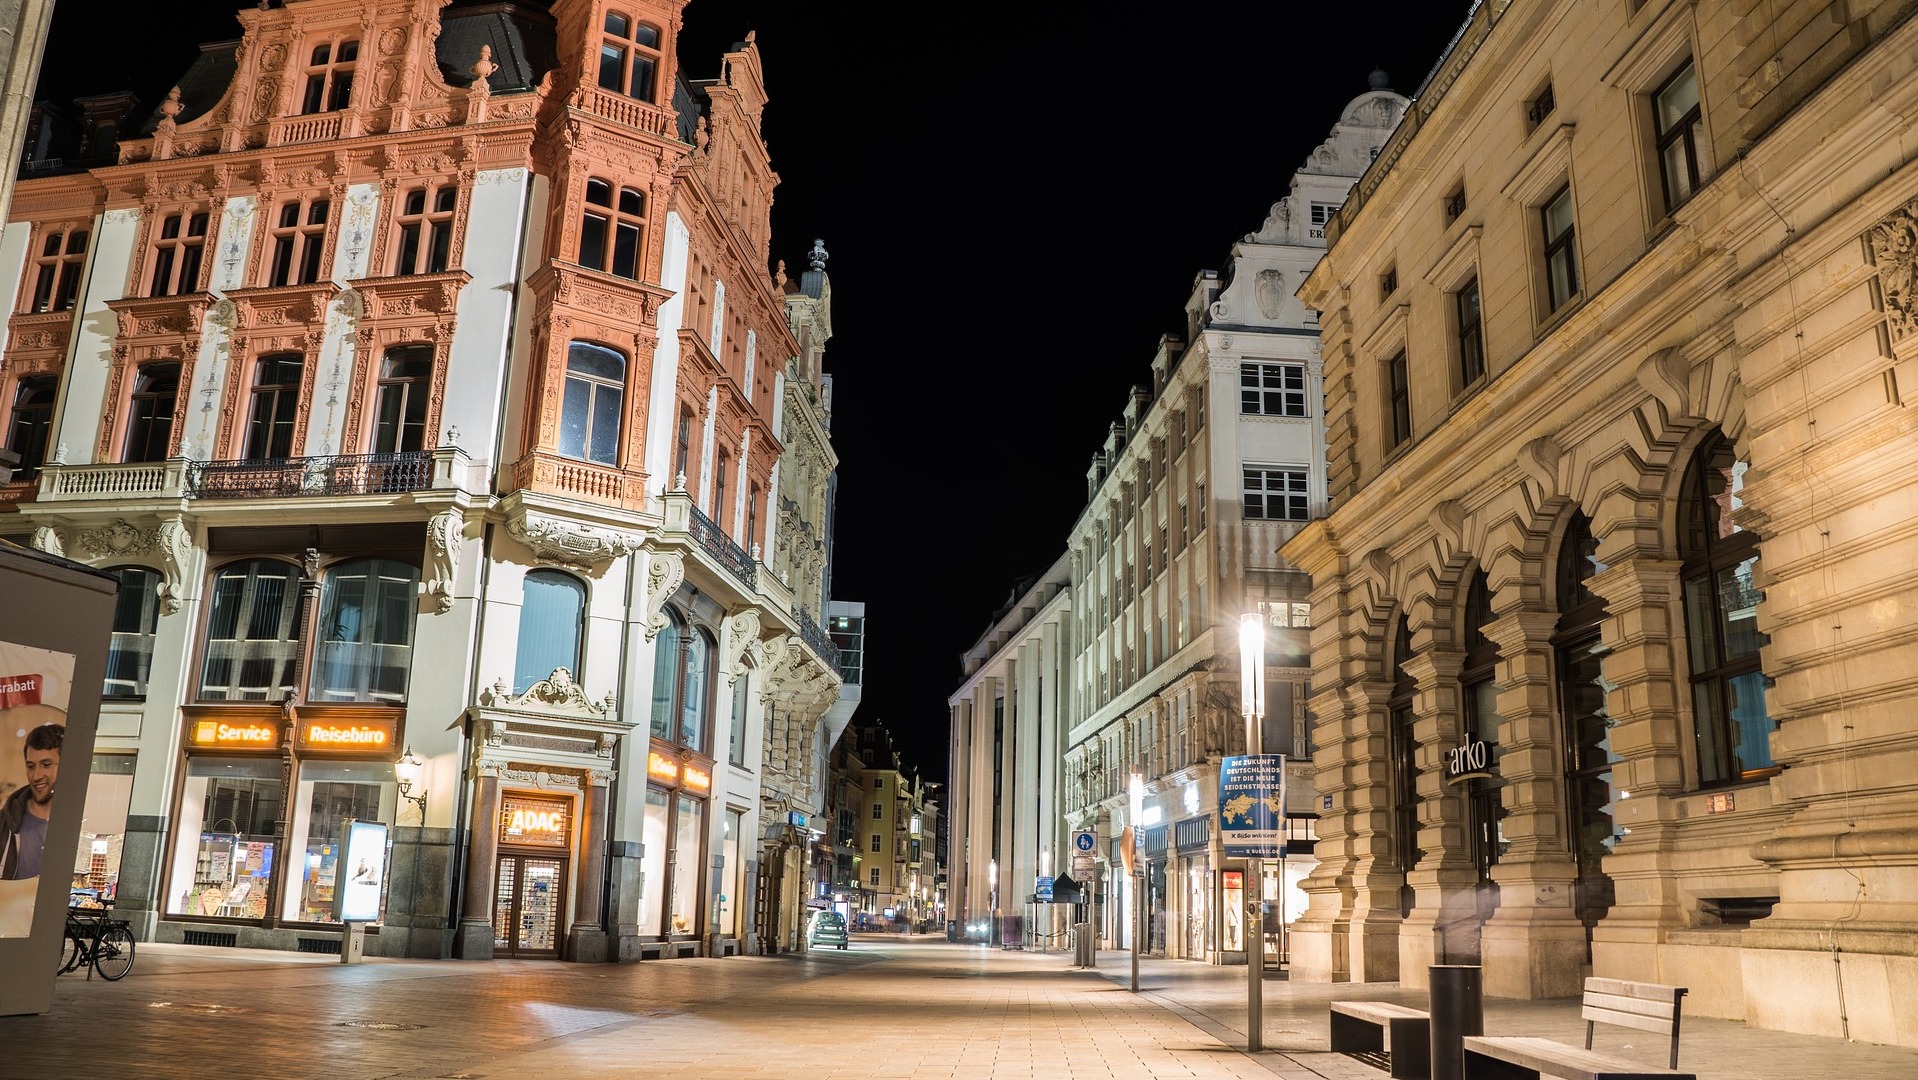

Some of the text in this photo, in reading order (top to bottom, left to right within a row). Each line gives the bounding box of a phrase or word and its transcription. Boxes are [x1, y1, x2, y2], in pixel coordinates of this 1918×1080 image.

[1310, 229, 1326, 238] ER
[217, 723, 271, 741] Service
[309, 726, 385, 743] Reisebüro
[1450, 732, 1486, 774] arko
[1226, 767, 1280, 775] DEUTSCHLANDS
[510, 810, 561, 832] ADAC
